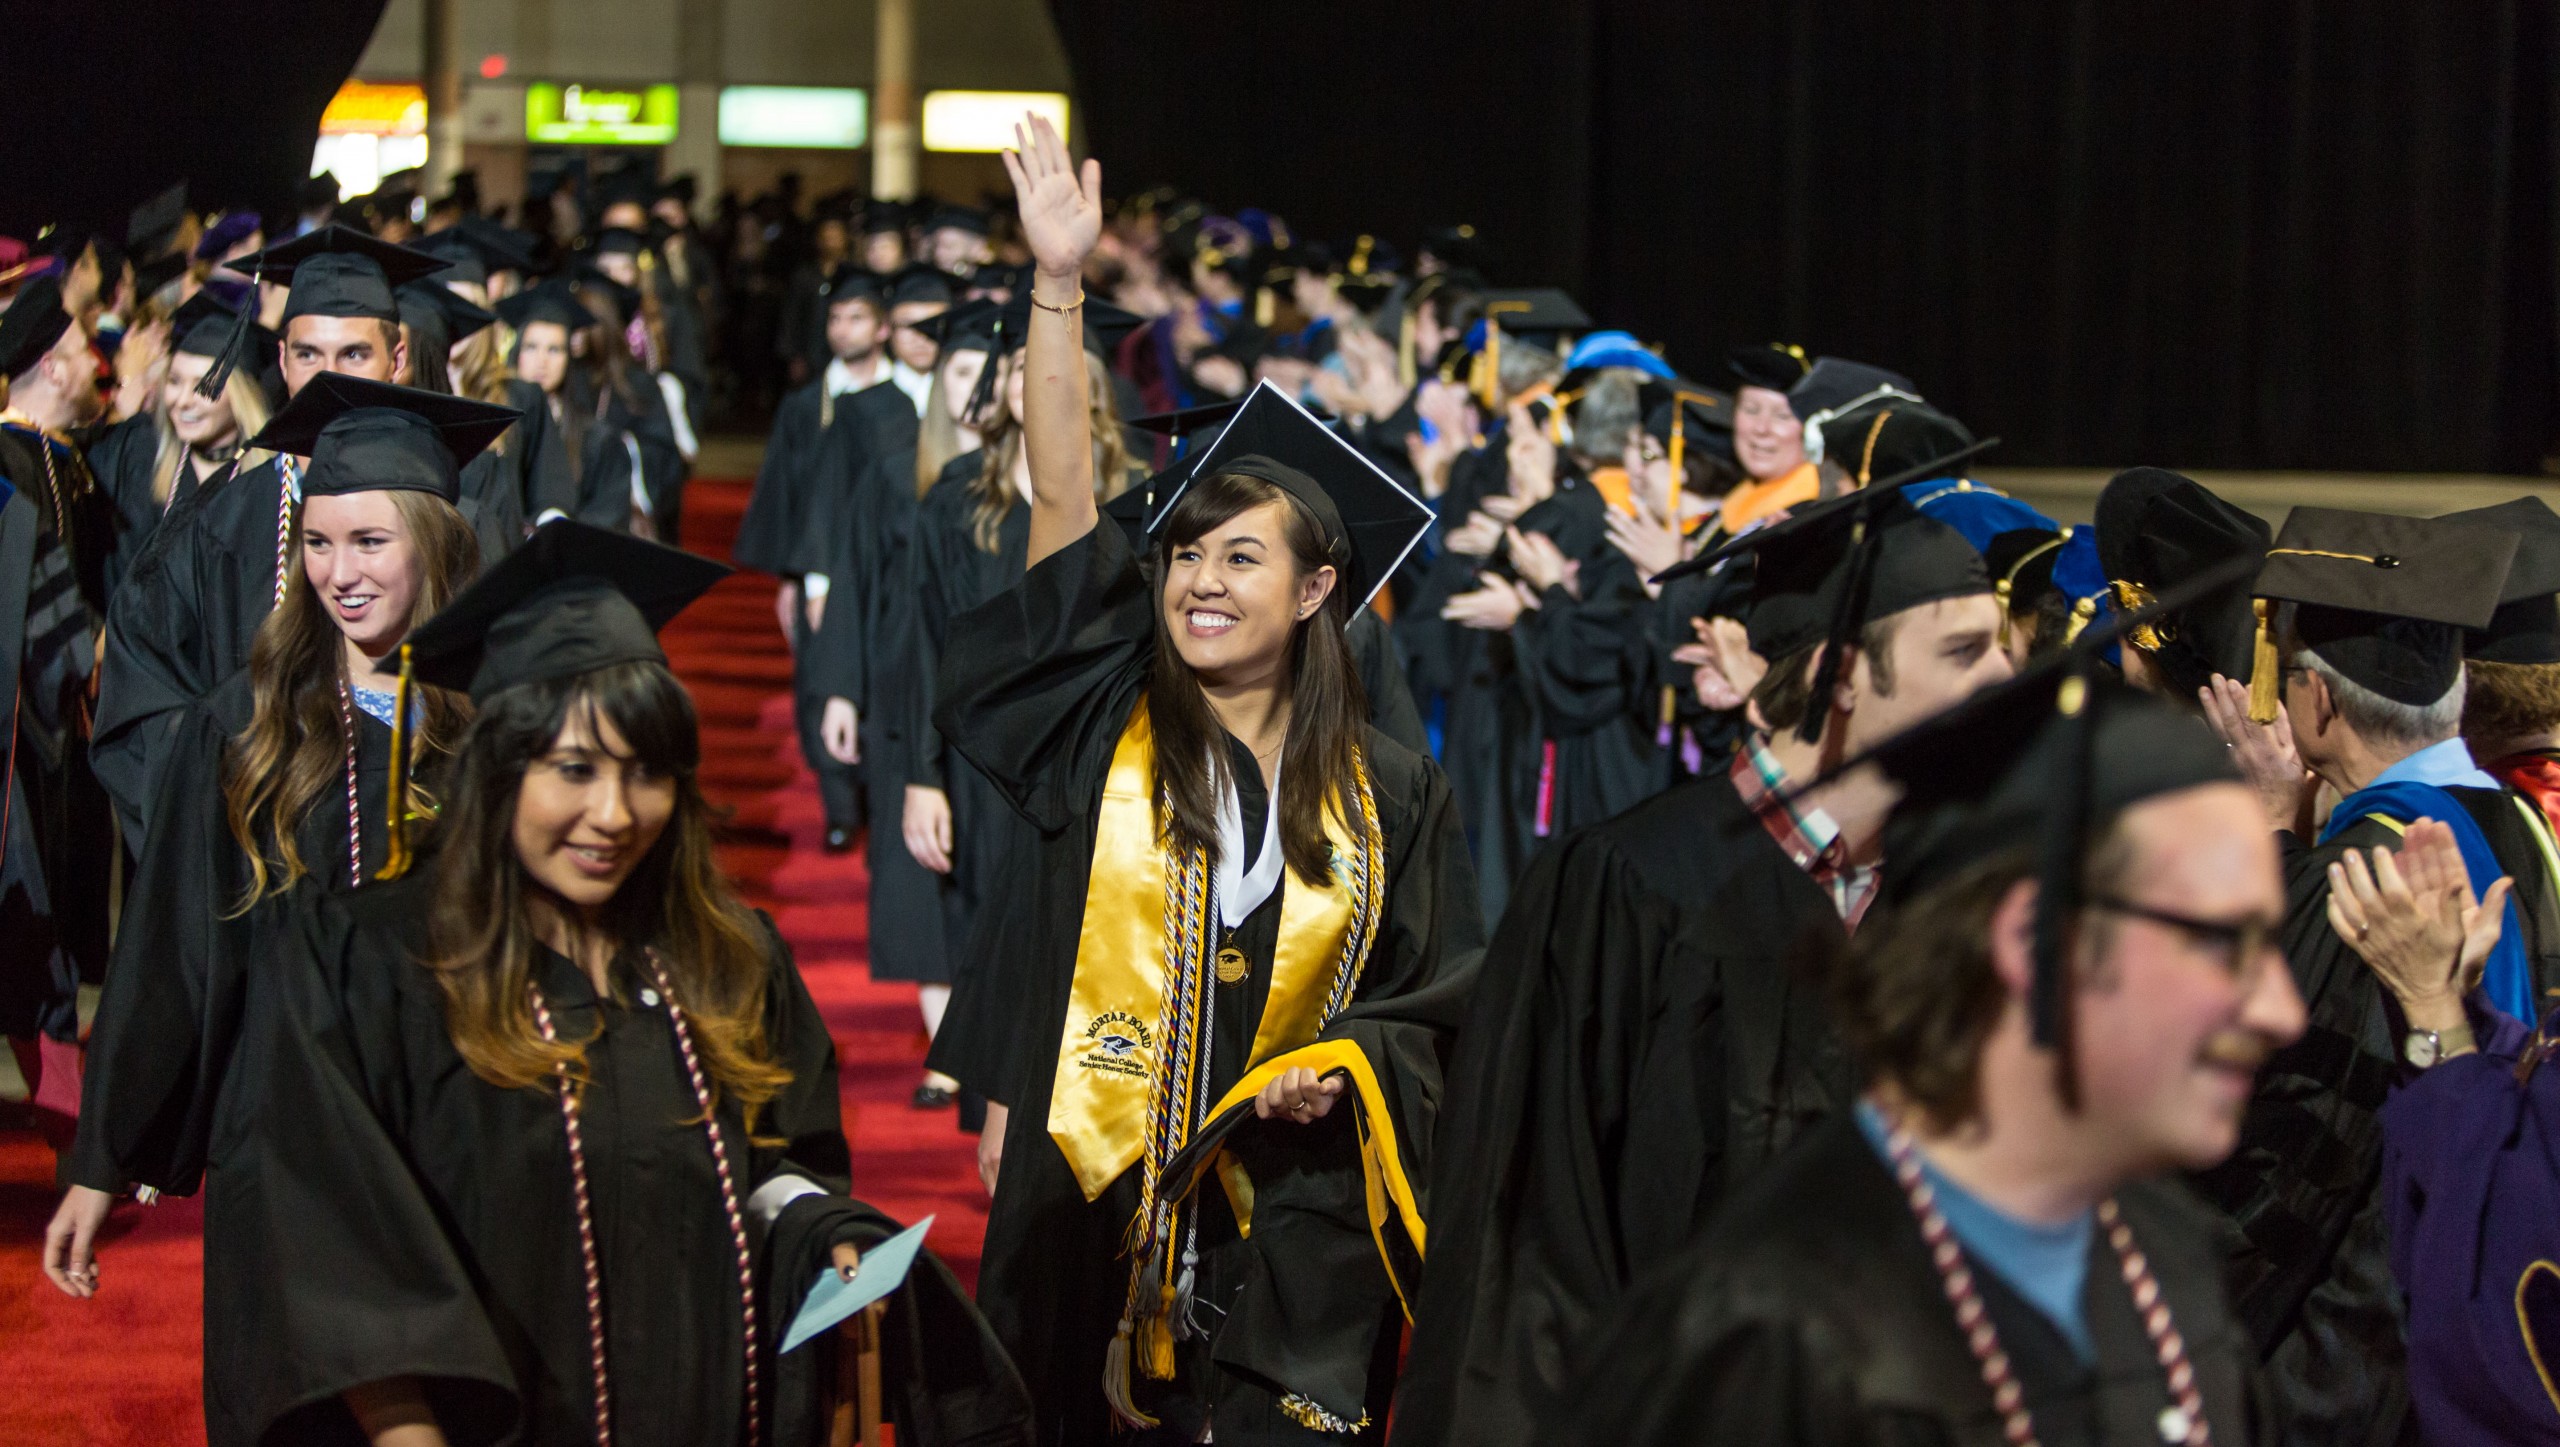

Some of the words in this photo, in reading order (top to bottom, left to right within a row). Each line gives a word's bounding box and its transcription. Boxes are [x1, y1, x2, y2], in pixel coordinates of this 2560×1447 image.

[1086, 1012, 1126, 1039] MORTAR
[1128, 1016, 1152, 1048] BOARD
[1079, 1061, 1101, 1069] Senior
[1102, 1063, 1123, 1073] Honor
[1124, 1068, 1149, 1079] Society
[1088, 1054, 1118, 1064] National
[1119, 1058, 1143, 1071] College
